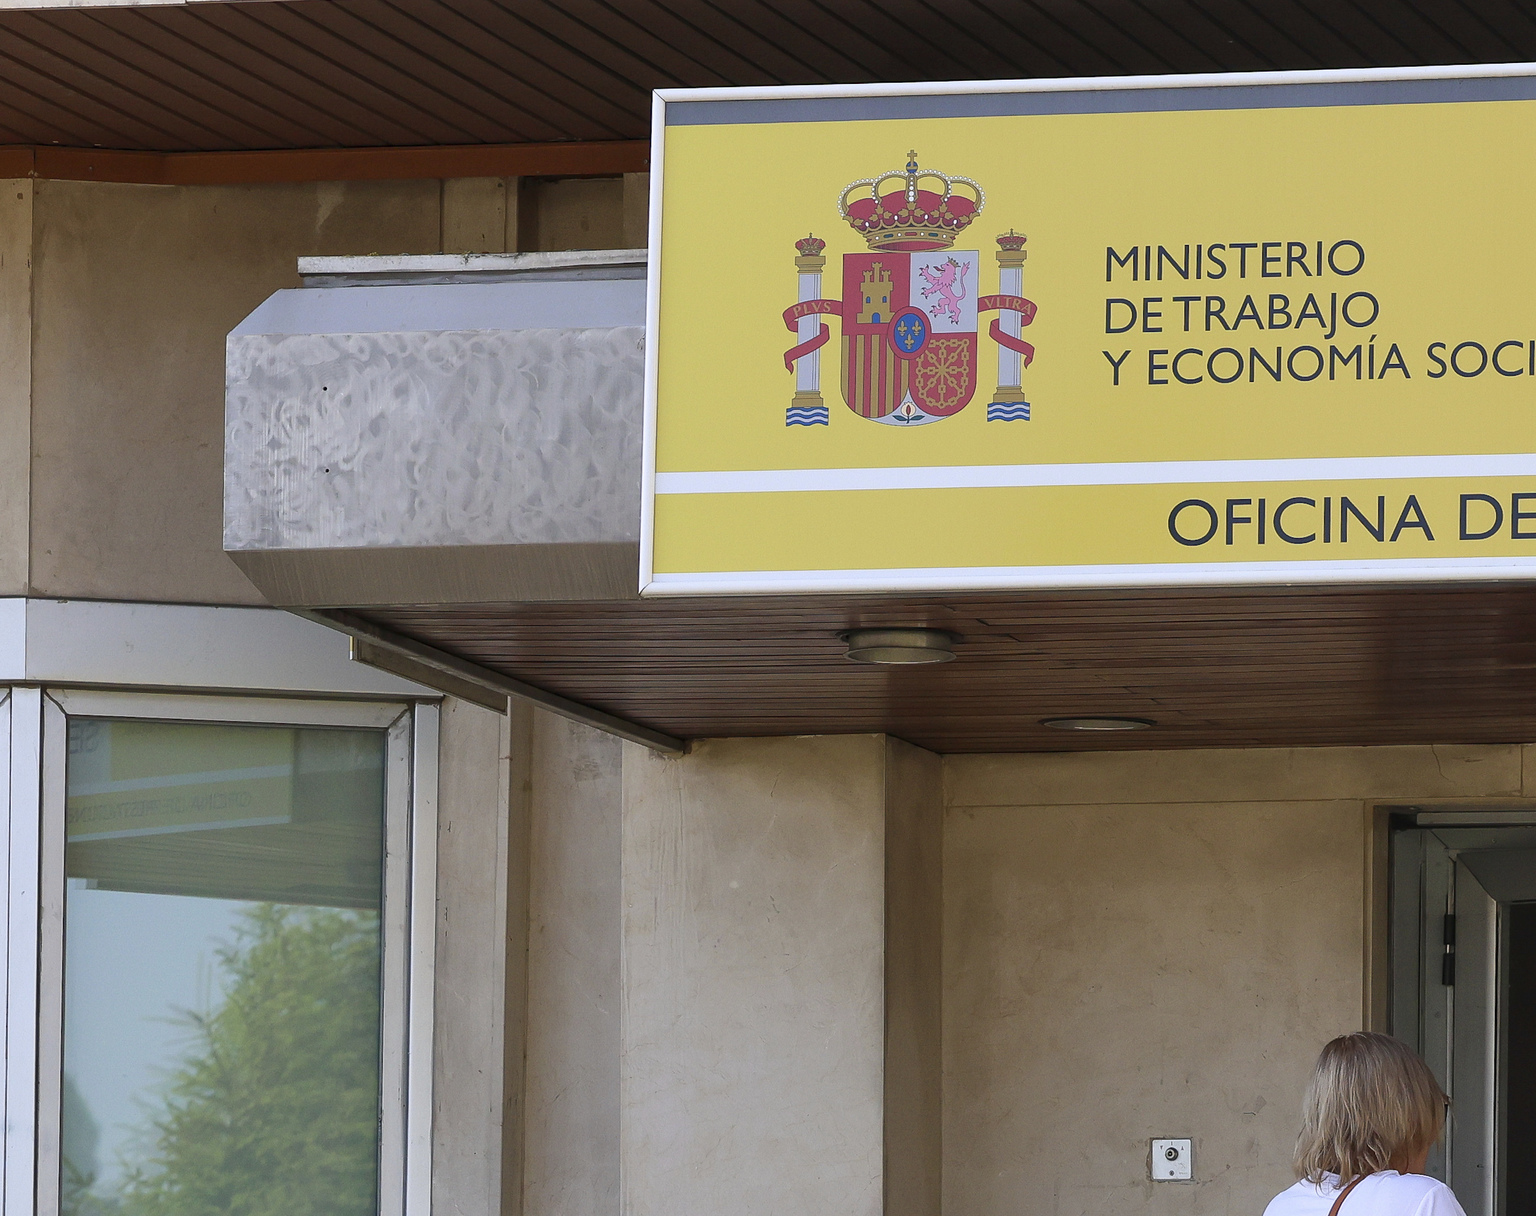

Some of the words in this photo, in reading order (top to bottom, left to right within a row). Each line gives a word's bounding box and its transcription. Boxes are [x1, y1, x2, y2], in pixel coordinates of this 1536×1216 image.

[1105, 239, 1366, 282] MINISTERIO
[792, 301, 832, 317] PLVS
[985, 297, 1033, 315] VLTRA
[1105, 297, 1163, 334] DE
[1184, 291, 1380, 339] TRABAJO
[1101, 350, 1132, 386] Y
[1149, 333, 1412, 385] ECONOMÍA
[1167, 494, 1436, 547] OFICINA
